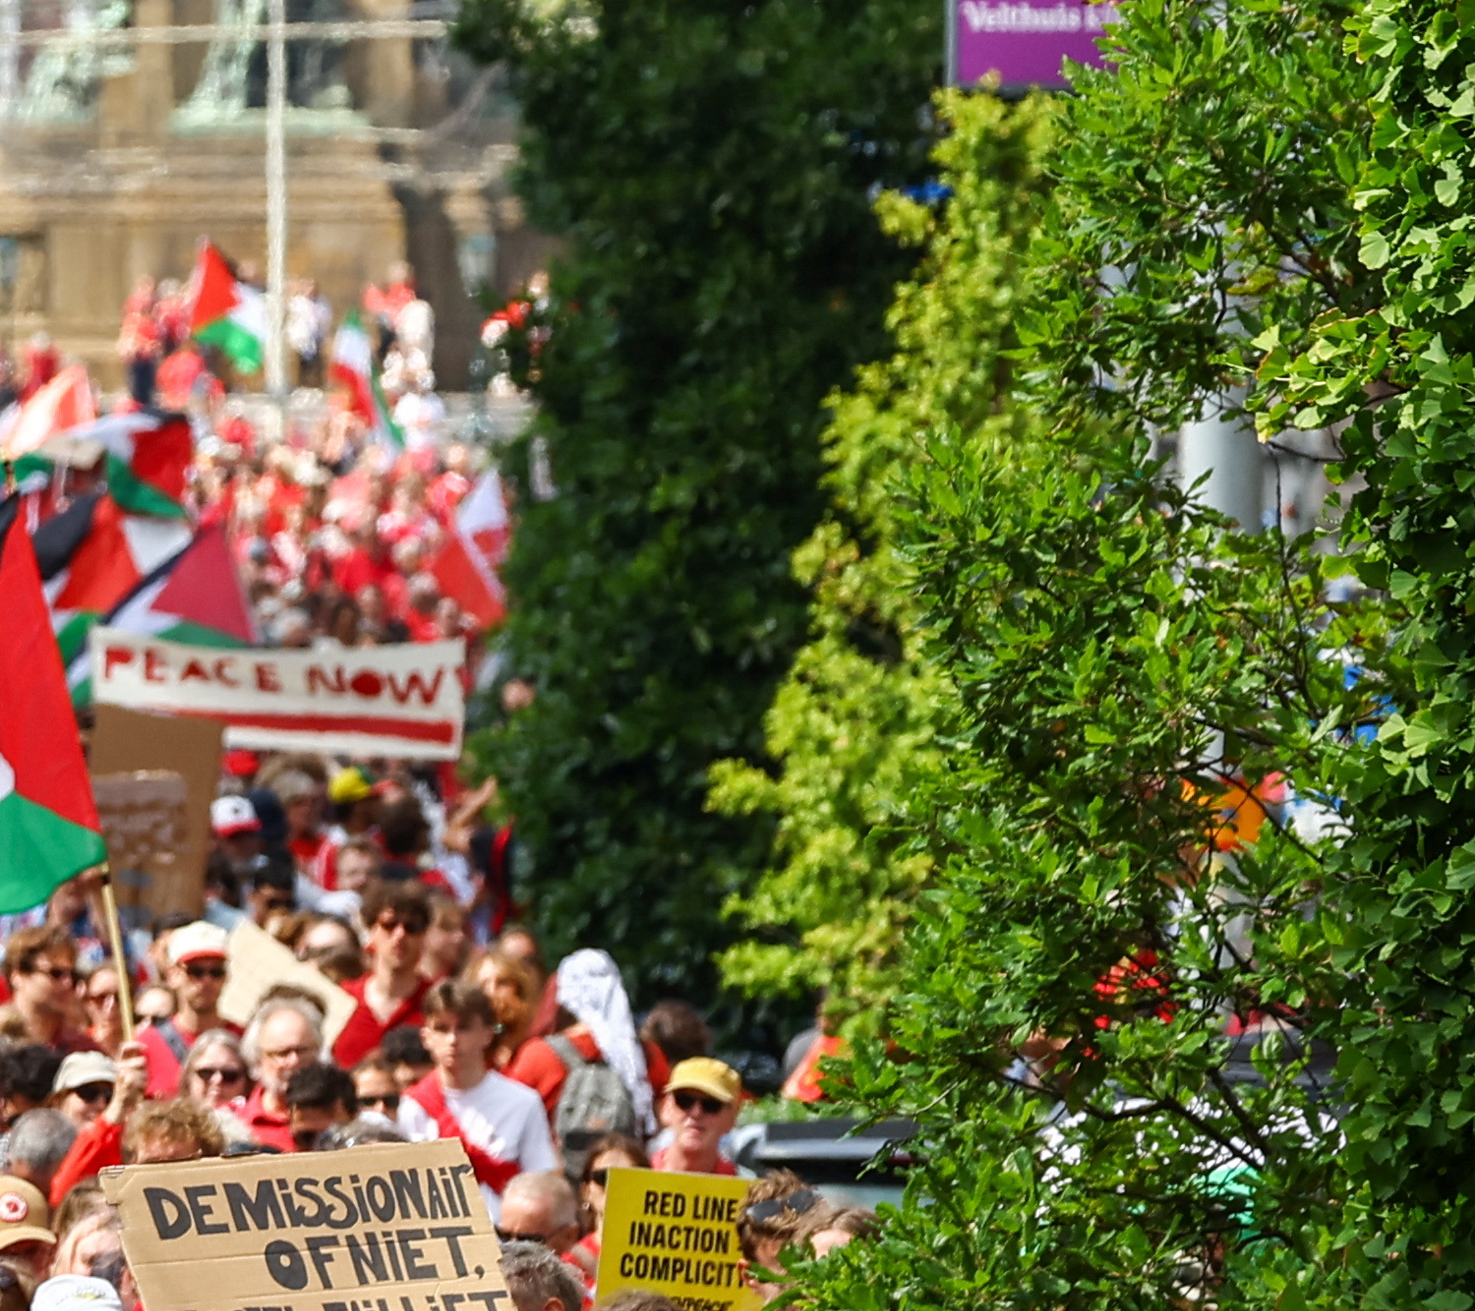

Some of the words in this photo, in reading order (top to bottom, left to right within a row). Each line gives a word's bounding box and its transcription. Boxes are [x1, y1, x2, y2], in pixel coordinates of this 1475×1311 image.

[961, 0, 1082, 33] Velthuis
[104, 646, 283, 692] PEACE
[305, 665, 445, 706] NOW
[644, 1190, 686, 1218] RED
[693, 1194, 739, 1223] LINE
[628, 1221, 730, 1255] INACTION
[264, 1234, 341, 1291] OF
